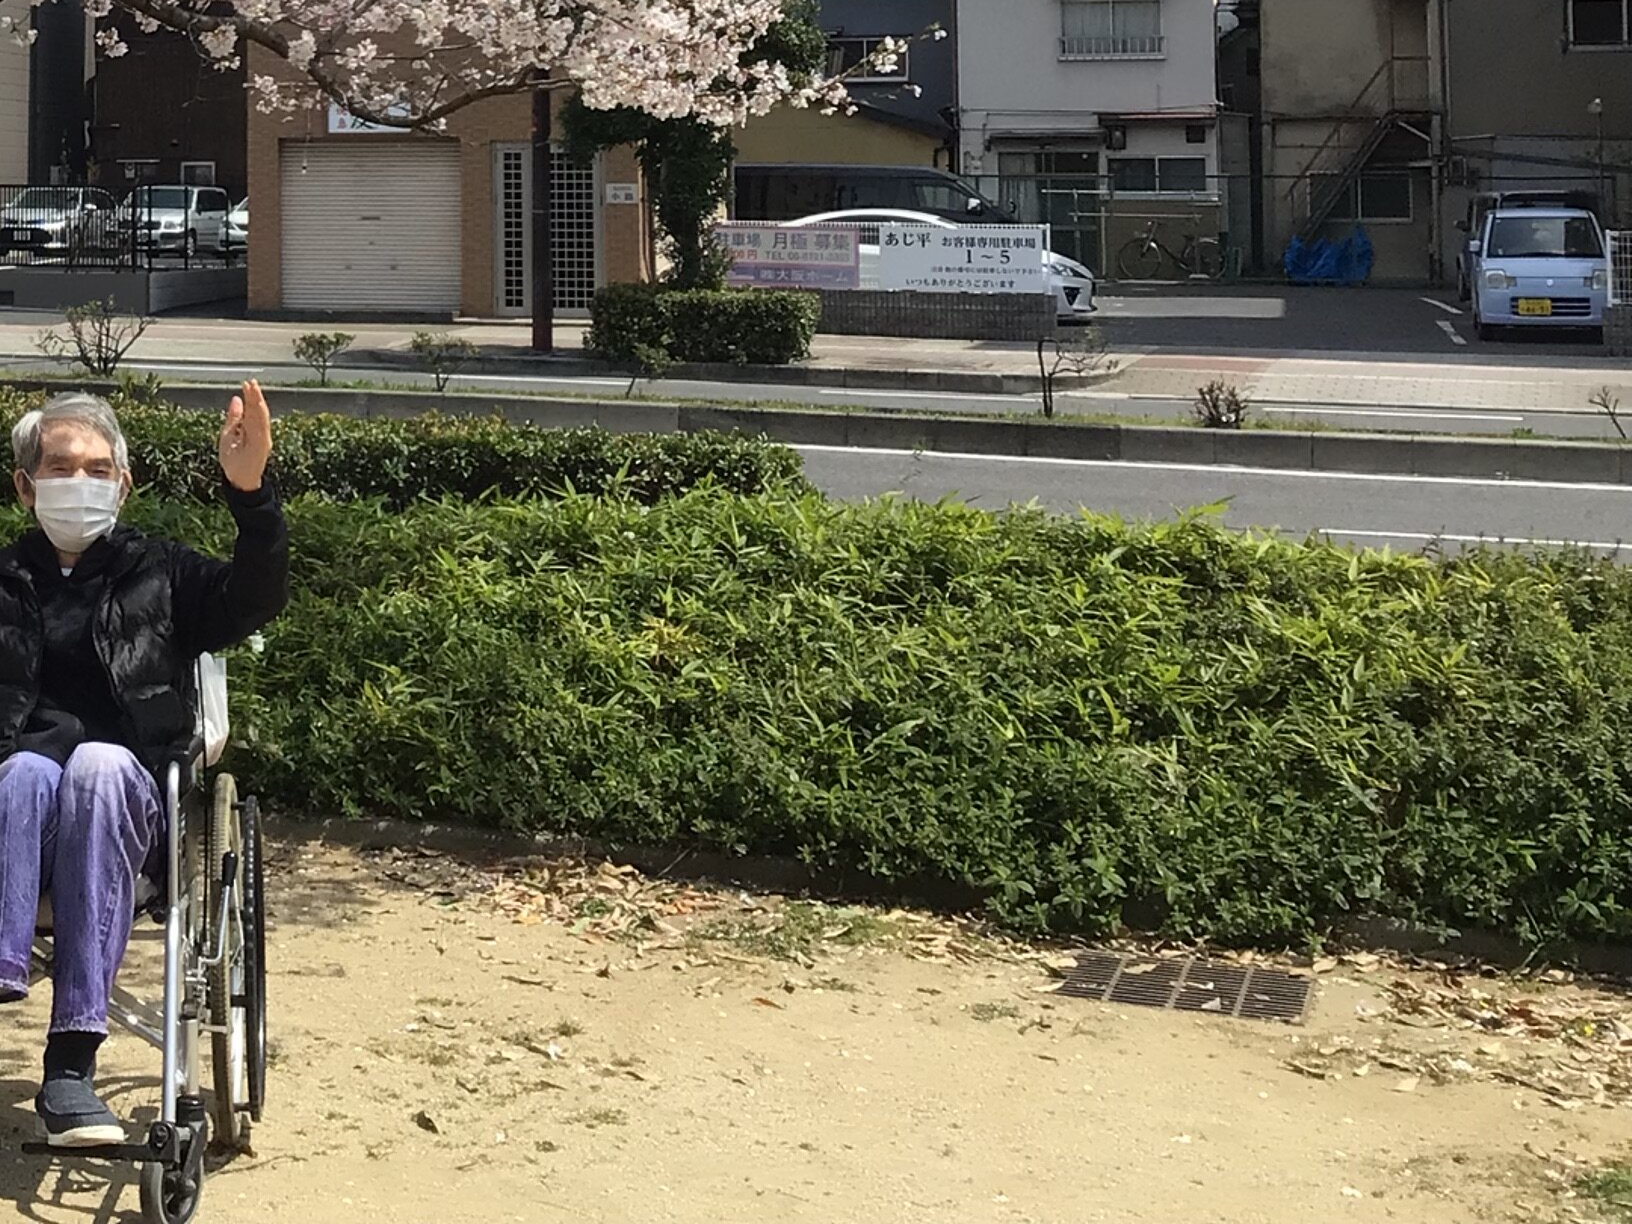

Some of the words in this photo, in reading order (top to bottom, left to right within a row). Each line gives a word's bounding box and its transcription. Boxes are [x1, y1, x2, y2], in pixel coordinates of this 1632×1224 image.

[773, 232, 808, 249] 月極
[884, 232, 931, 248] あじ平
[941, 236, 1036, 249] お客様専用駐車場
[905, 278, 1016, 288] いつもありがとうございます
